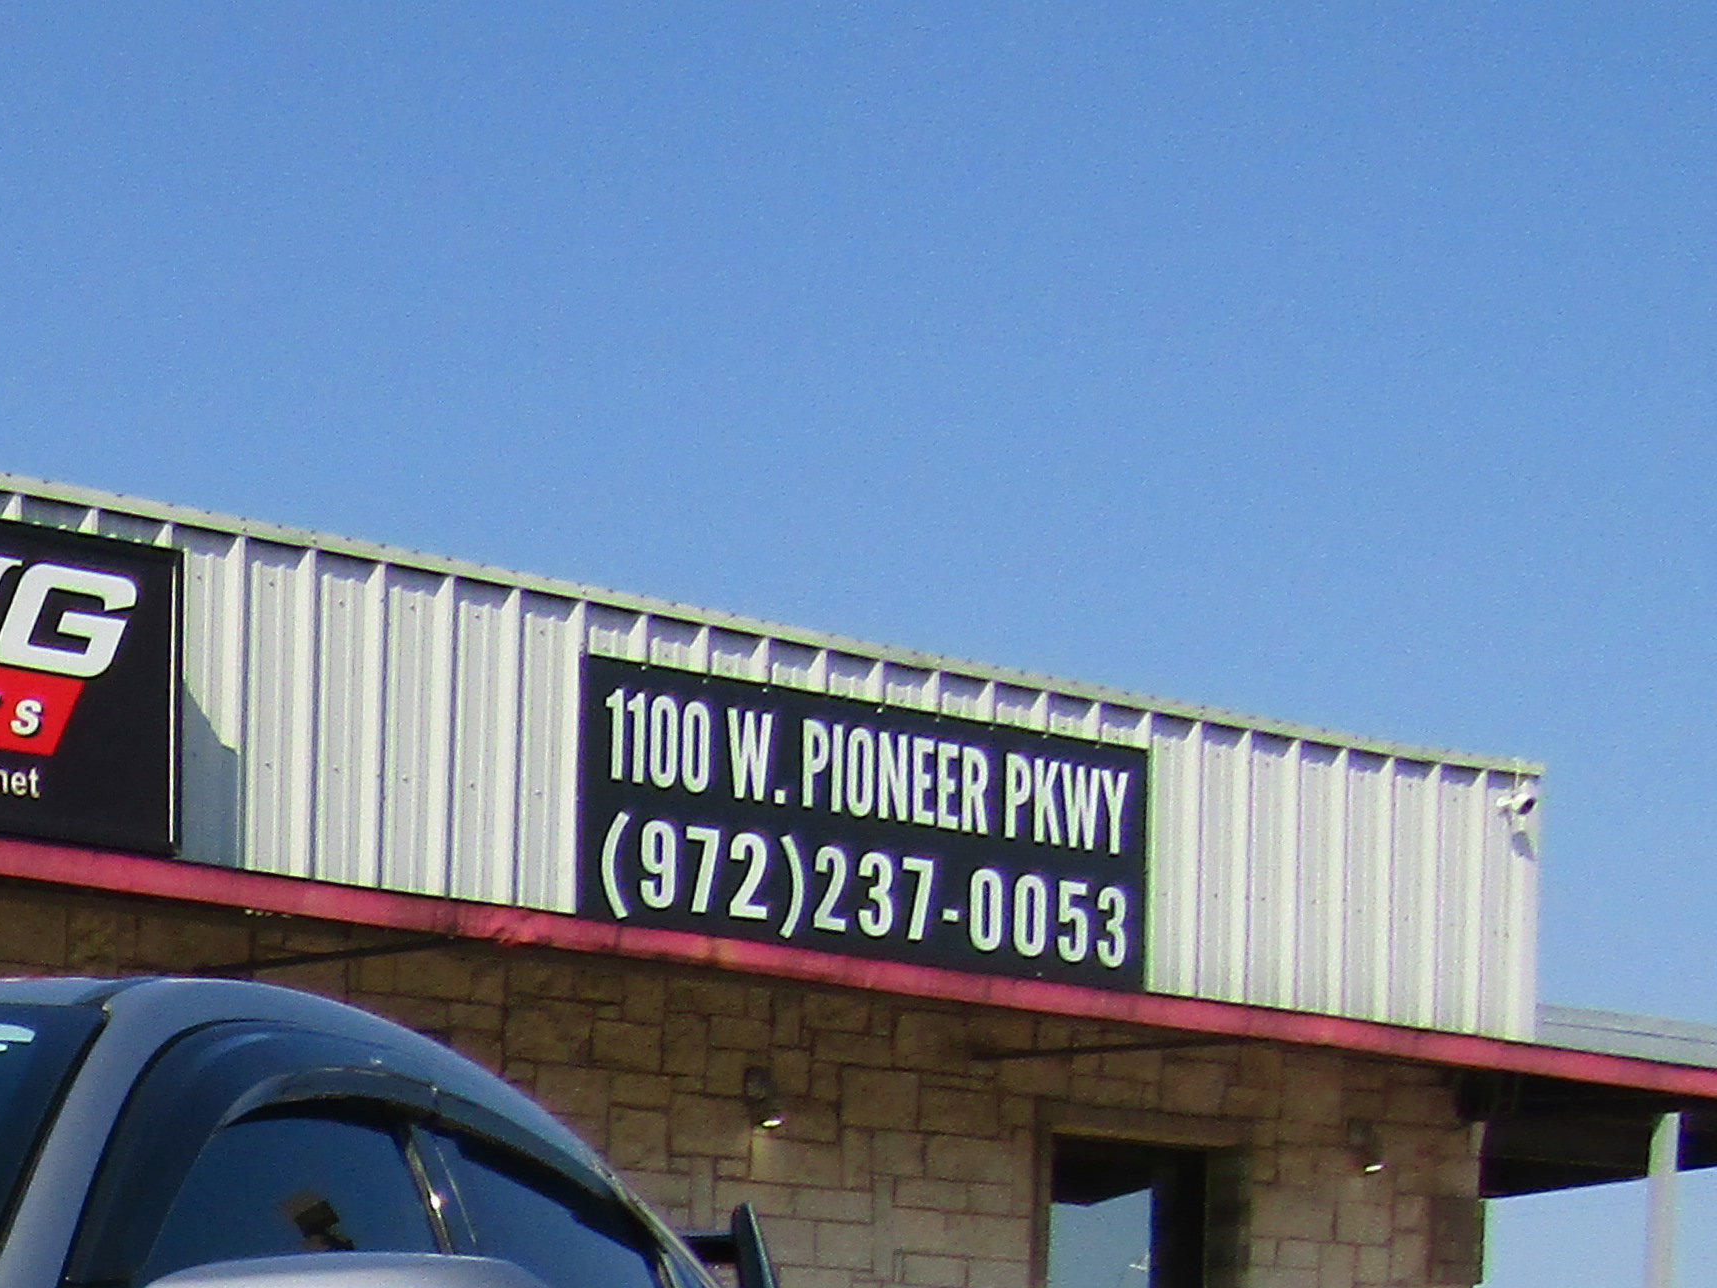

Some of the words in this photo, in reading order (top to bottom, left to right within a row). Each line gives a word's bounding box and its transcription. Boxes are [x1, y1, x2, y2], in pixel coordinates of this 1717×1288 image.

[604, 687, 712, 794] 1100
[726, 706, 787, 806] W.
[801, 717, 990, 836] PIONEER
[1003, 751, 1131, 856] PKWY
[600, 810, 1128, 969] (972)237-0053
